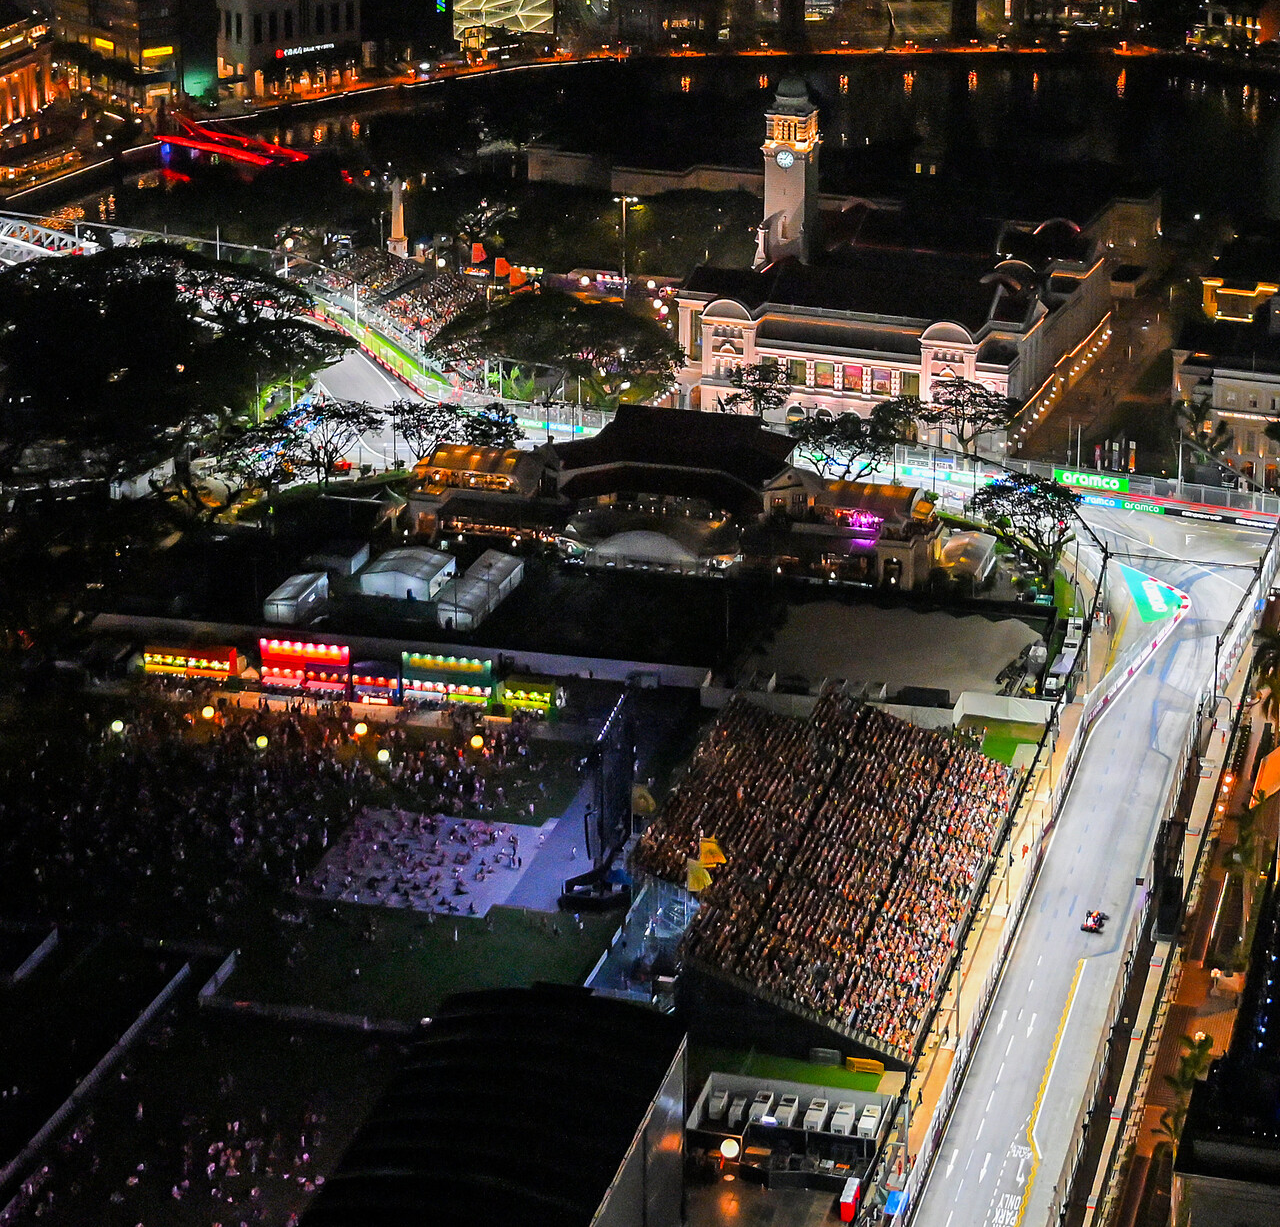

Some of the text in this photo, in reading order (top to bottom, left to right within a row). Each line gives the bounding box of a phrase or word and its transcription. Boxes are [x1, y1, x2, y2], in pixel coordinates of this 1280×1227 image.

[1062, 472, 1120, 490] aramco
[1124, 502, 1159, 513] aramco
[998, 1193, 1022, 1211] ONLY
[992, 1208, 1020, 1226] PARK
